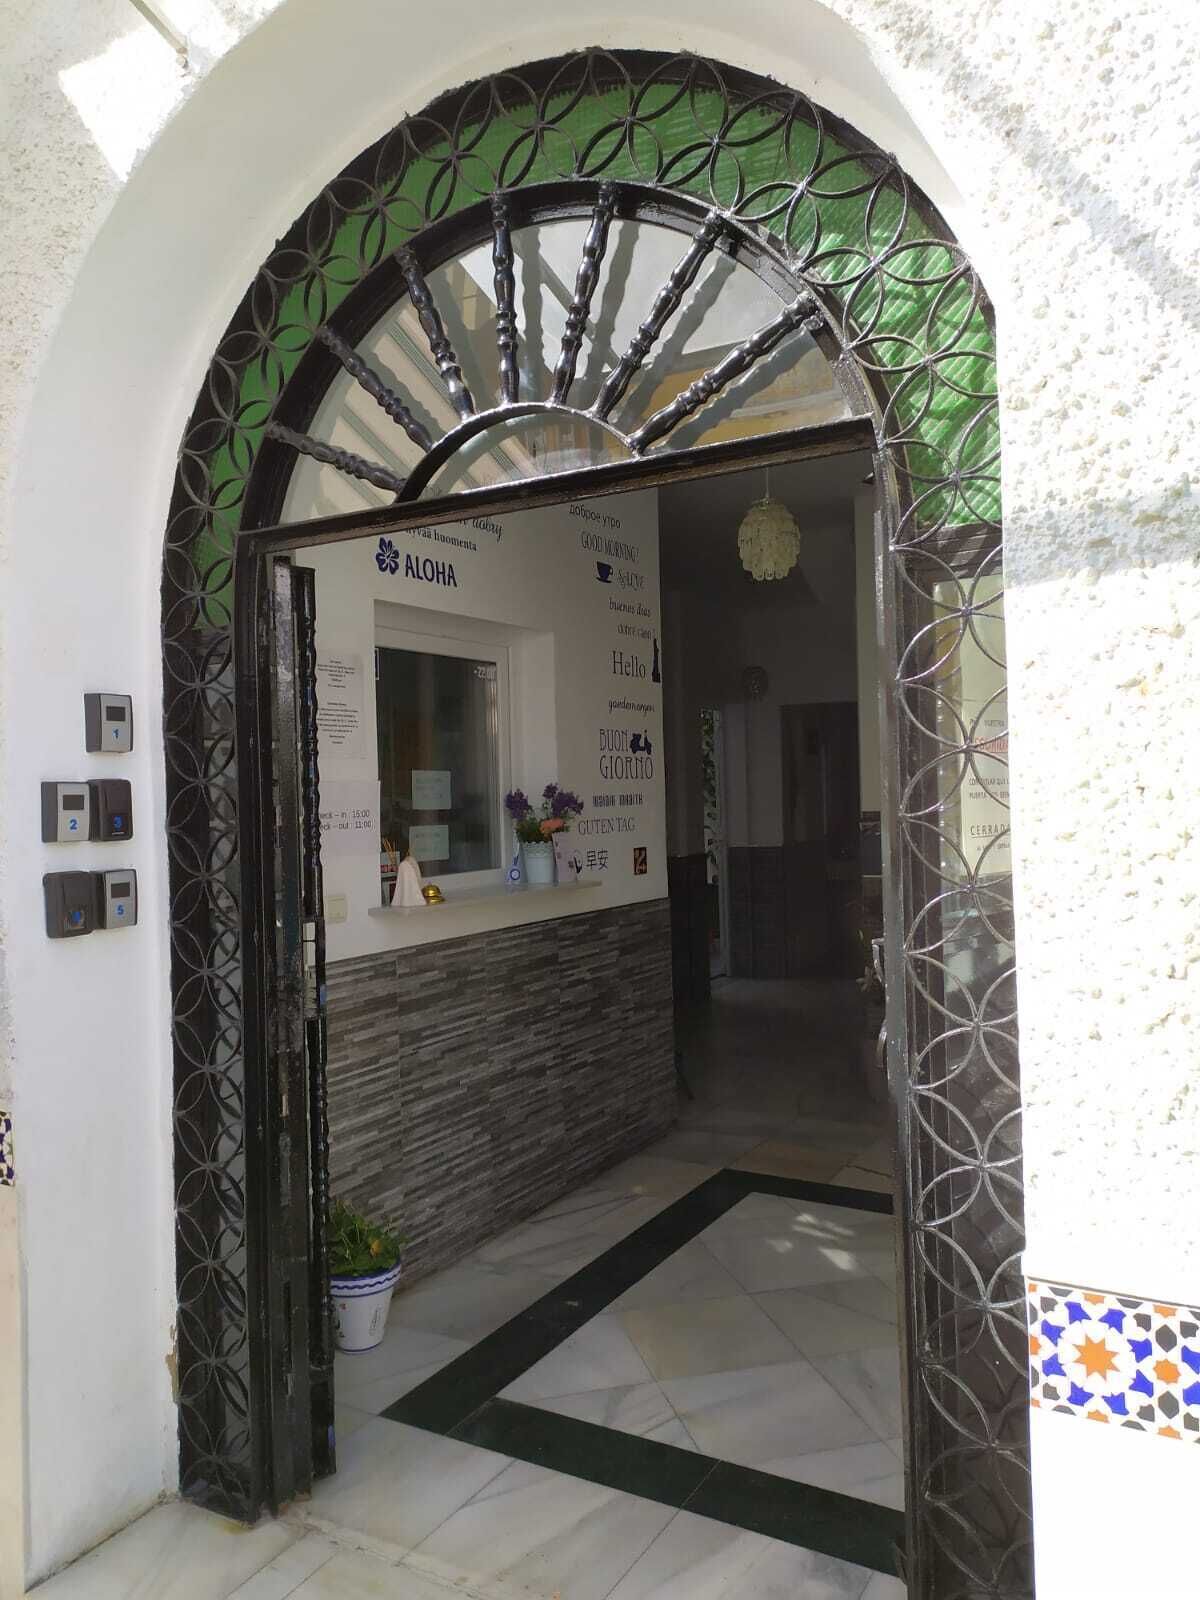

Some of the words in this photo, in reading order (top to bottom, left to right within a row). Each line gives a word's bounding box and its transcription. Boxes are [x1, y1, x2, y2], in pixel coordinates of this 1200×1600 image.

[581, 531, 602, 552] GOOD
[405, 553, 458, 587] ALOHA
[612, 650, 646, 679] Hello
[113, 728, 119, 739] 1
[600, 729, 628, 751] BUON
[600, 755, 653, 780] GIORNO
[70, 818, 77, 831] 2
[578, 818, 614, 836] GUTEN
[615, 816, 635, 833] TAG
[586, 850, 608, 870] 早安
[116, 904, 125, 916] 5
